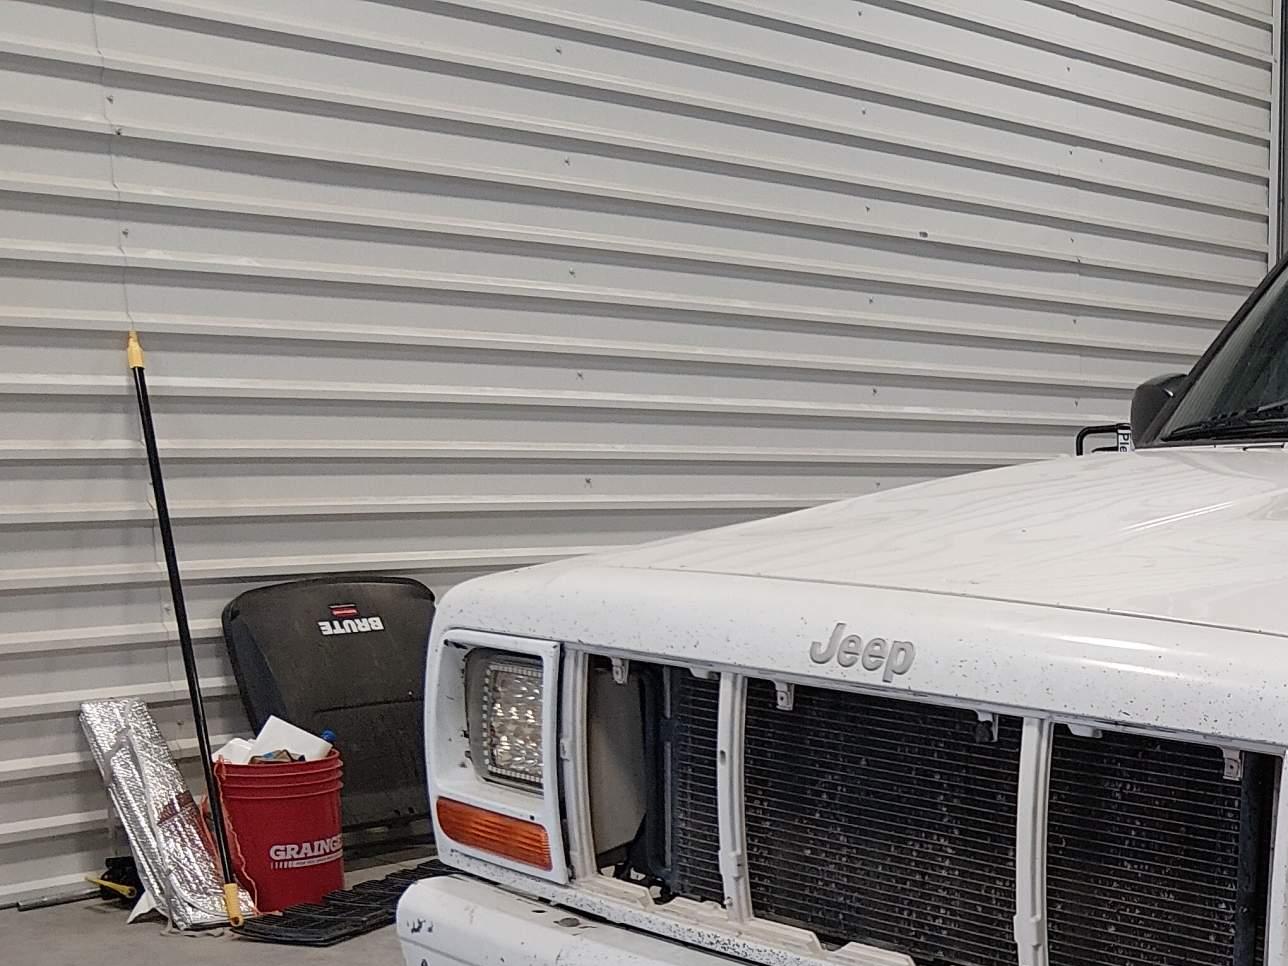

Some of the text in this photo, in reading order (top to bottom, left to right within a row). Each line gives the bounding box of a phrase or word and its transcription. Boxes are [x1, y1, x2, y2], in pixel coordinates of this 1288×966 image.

[317, 616, 385, 636] BRUTE
[809, 622, 916, 683] Jeep
[269, 833, 343, 861] GRAING
